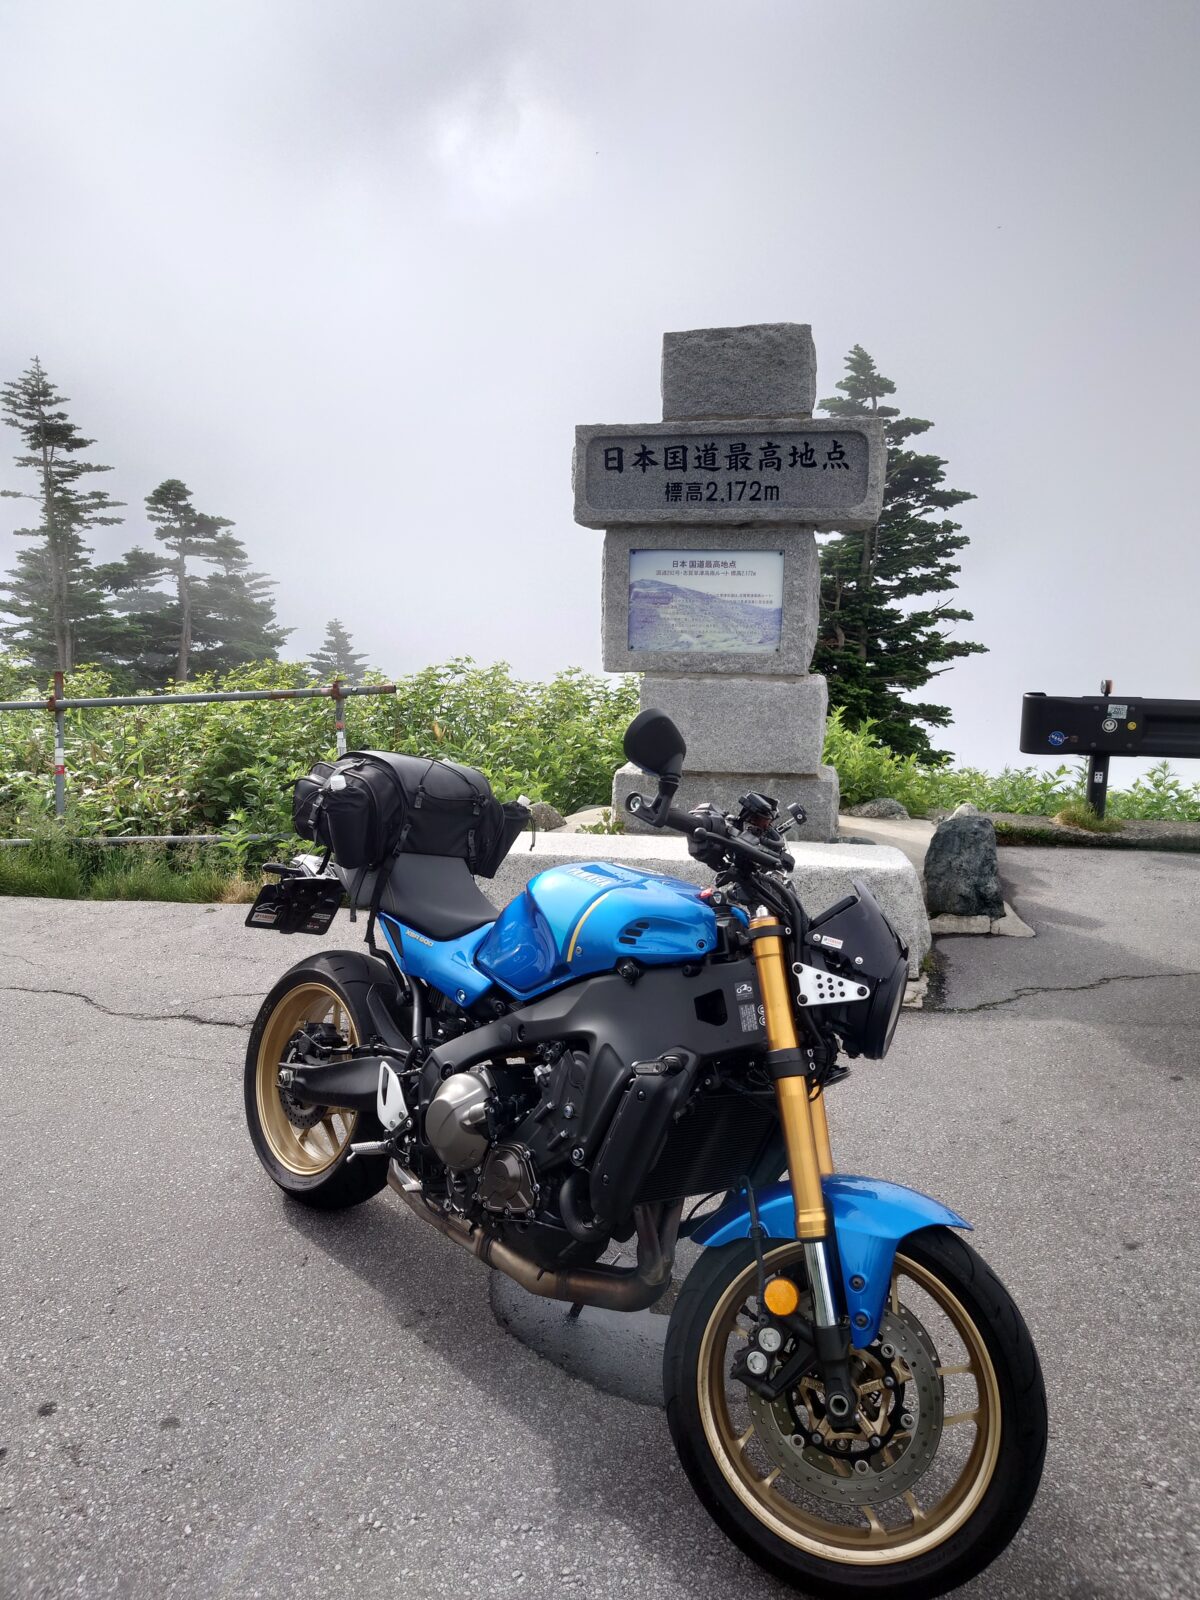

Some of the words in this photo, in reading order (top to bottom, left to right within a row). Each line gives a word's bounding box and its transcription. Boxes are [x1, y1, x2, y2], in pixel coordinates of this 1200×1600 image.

[603, 439, 850, 474] 日本国道最高地点
[664, 480, 780, 502] 標高2,172m
